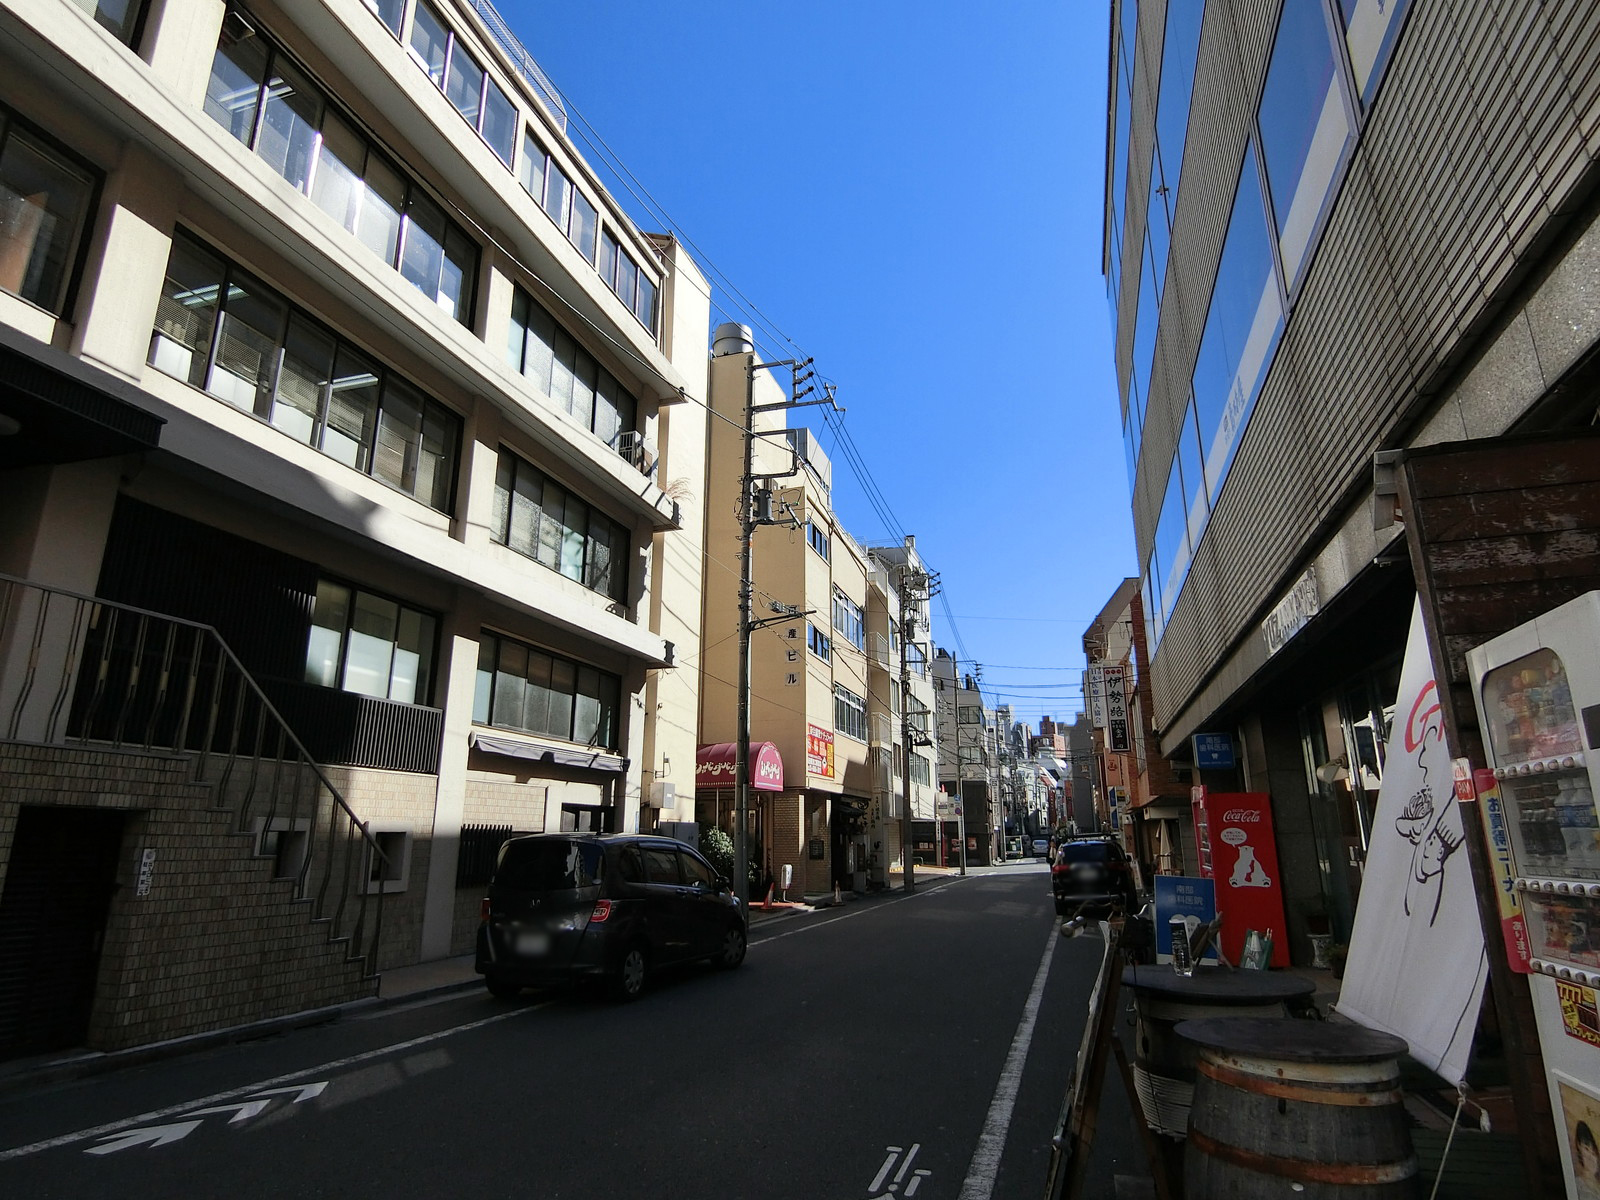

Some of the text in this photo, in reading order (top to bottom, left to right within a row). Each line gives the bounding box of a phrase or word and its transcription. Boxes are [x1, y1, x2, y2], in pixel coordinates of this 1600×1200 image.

[1107, 676, 1125, 717] 伊勢路
[1223, 809, 1261, 823] Coca-Cola
[1487, 797, 1517, 907] お買得コーナー
